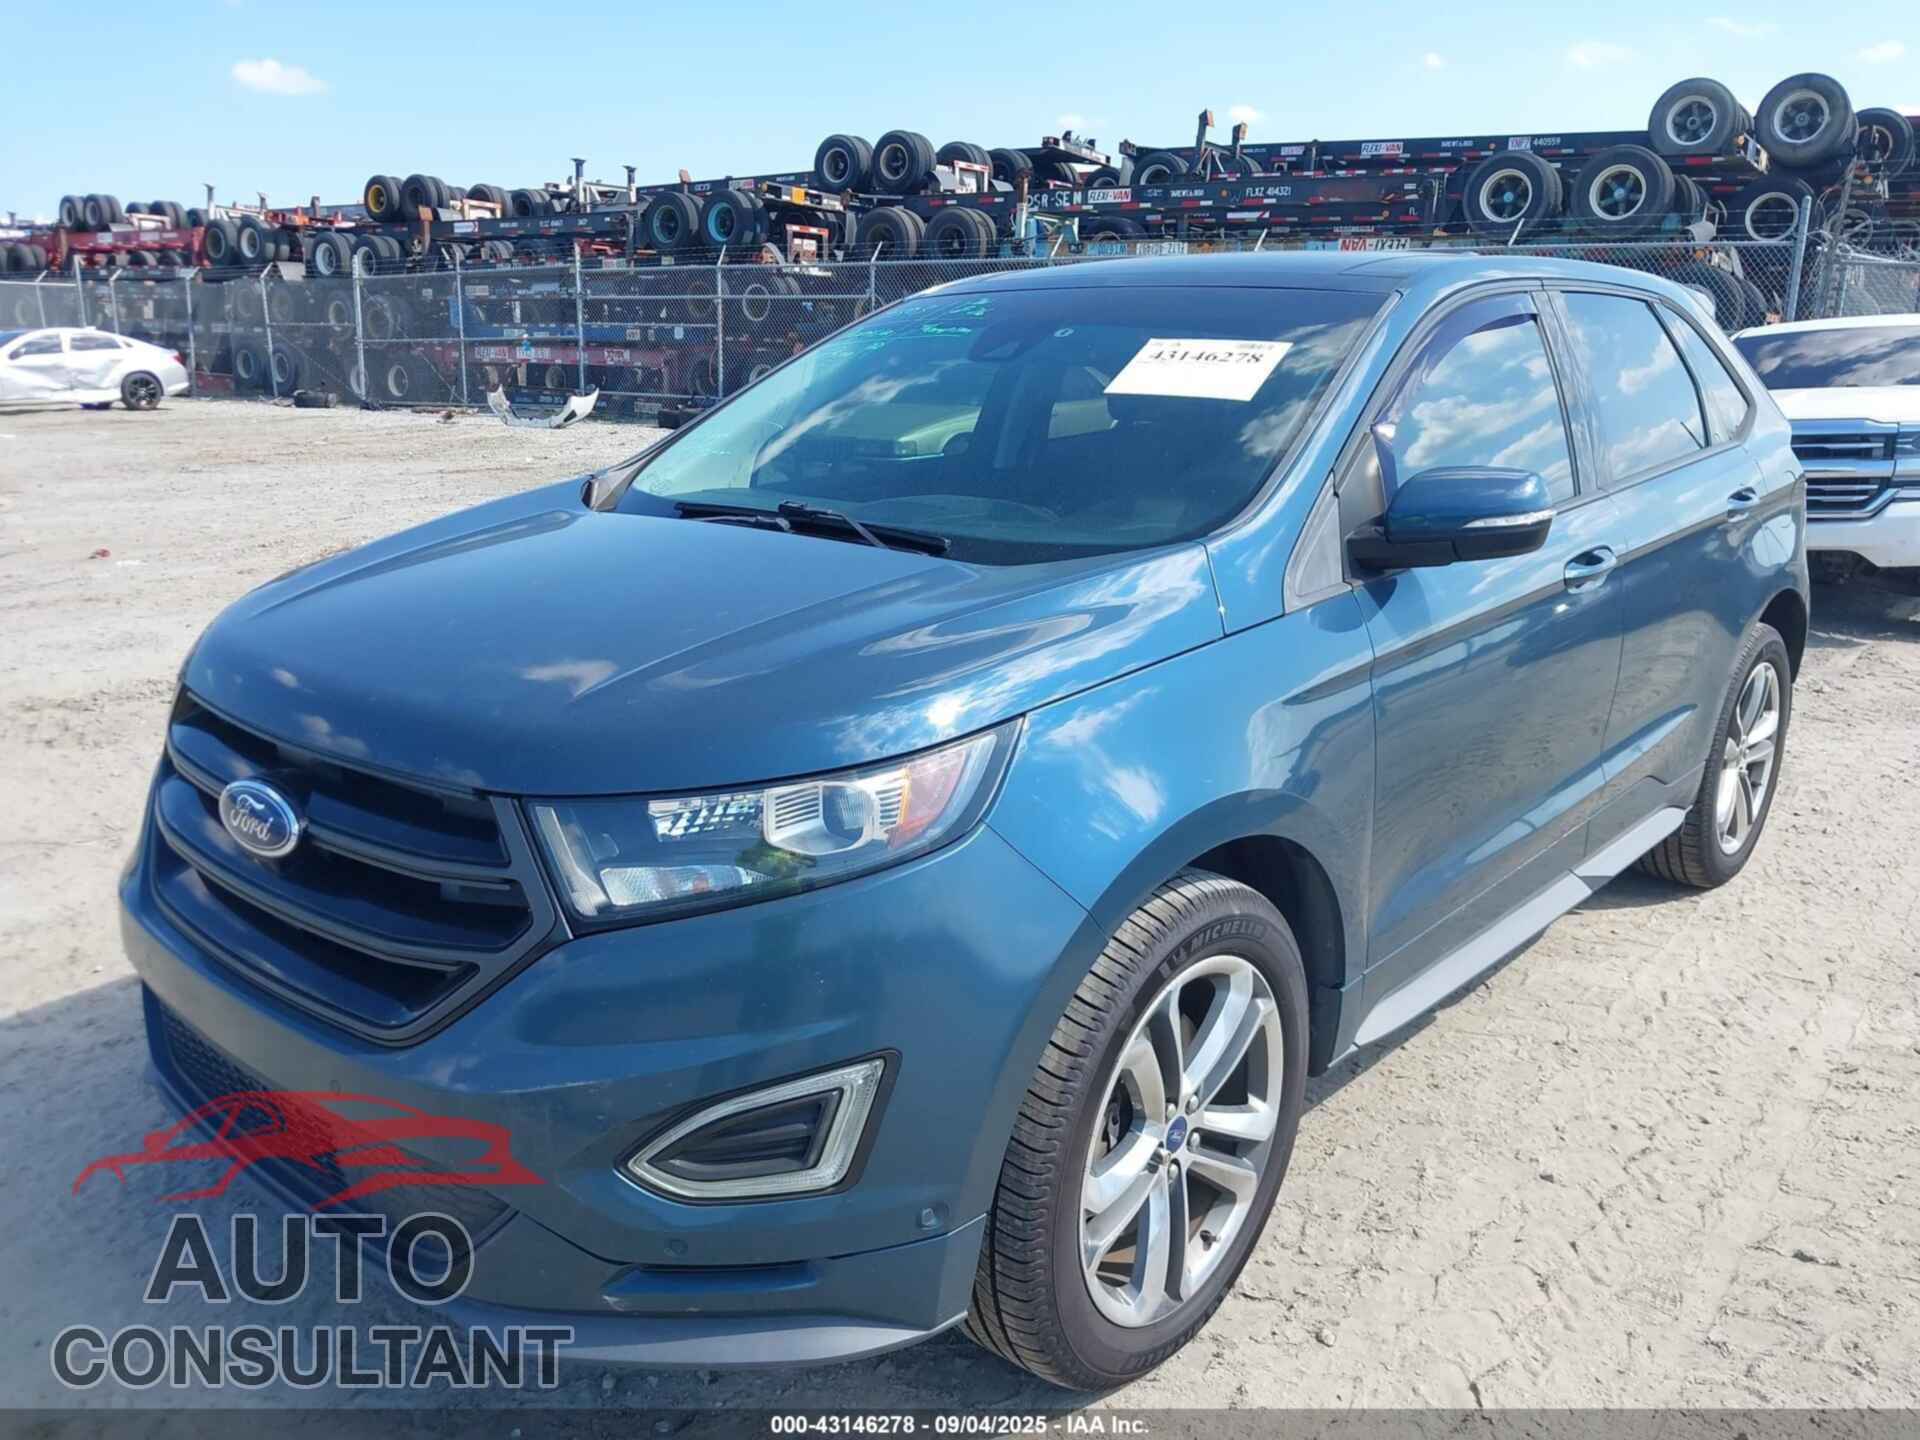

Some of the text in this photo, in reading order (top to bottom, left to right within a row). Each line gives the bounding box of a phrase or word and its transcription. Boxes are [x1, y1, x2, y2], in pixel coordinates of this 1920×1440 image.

[1089, 189, 1131, 202] FLEXI-VAN
[1149, 350, 1264, 363] 43146278
[230, 794, 274, 841] Ford
[1190, 918, 1267, 952] MICHELIN
